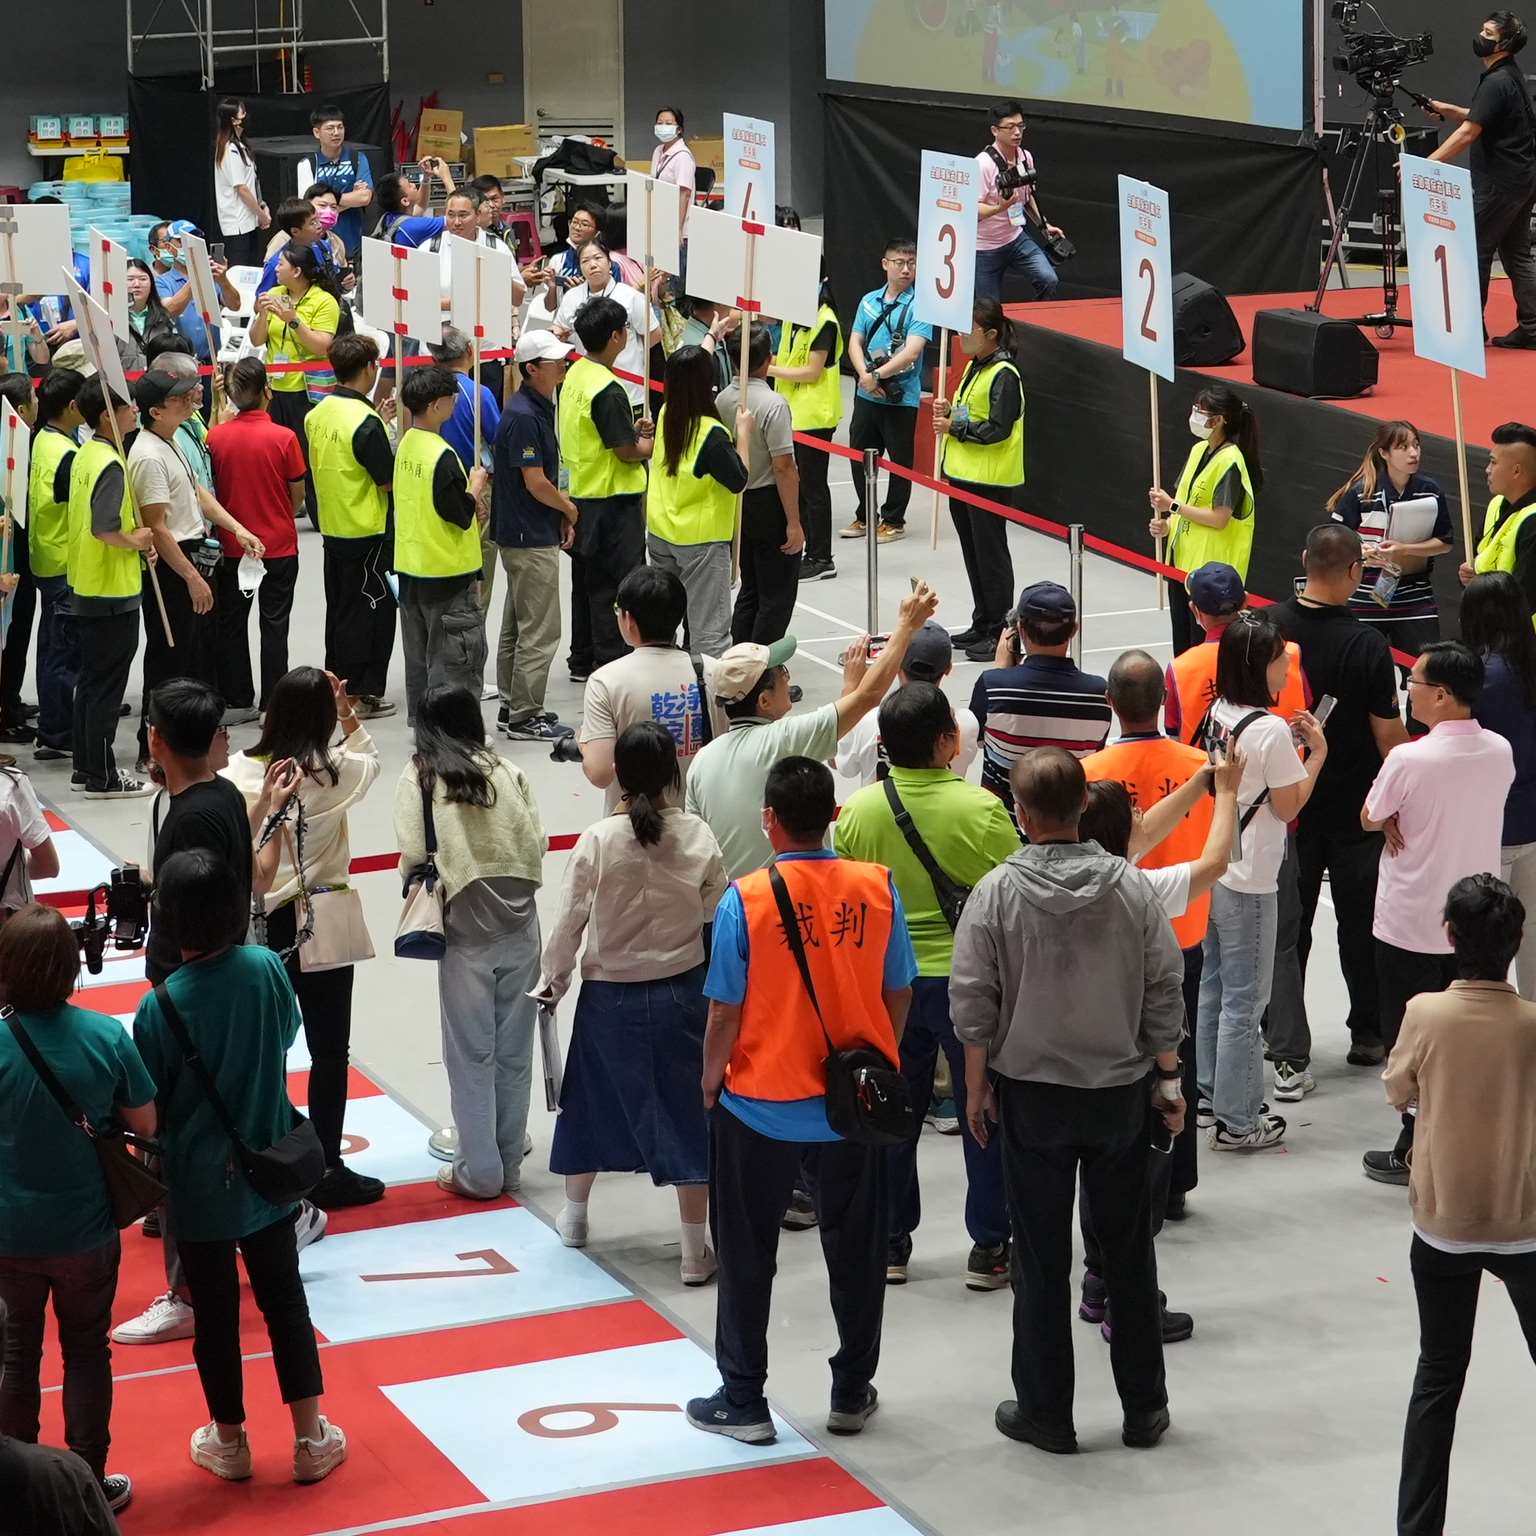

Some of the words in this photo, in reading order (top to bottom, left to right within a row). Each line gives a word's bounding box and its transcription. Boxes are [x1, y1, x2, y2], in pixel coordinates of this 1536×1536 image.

[935, 223, 957, 299] 3
[1138, 257, 1158, 343] 2
[1434, 244, 1452, 333] 1
